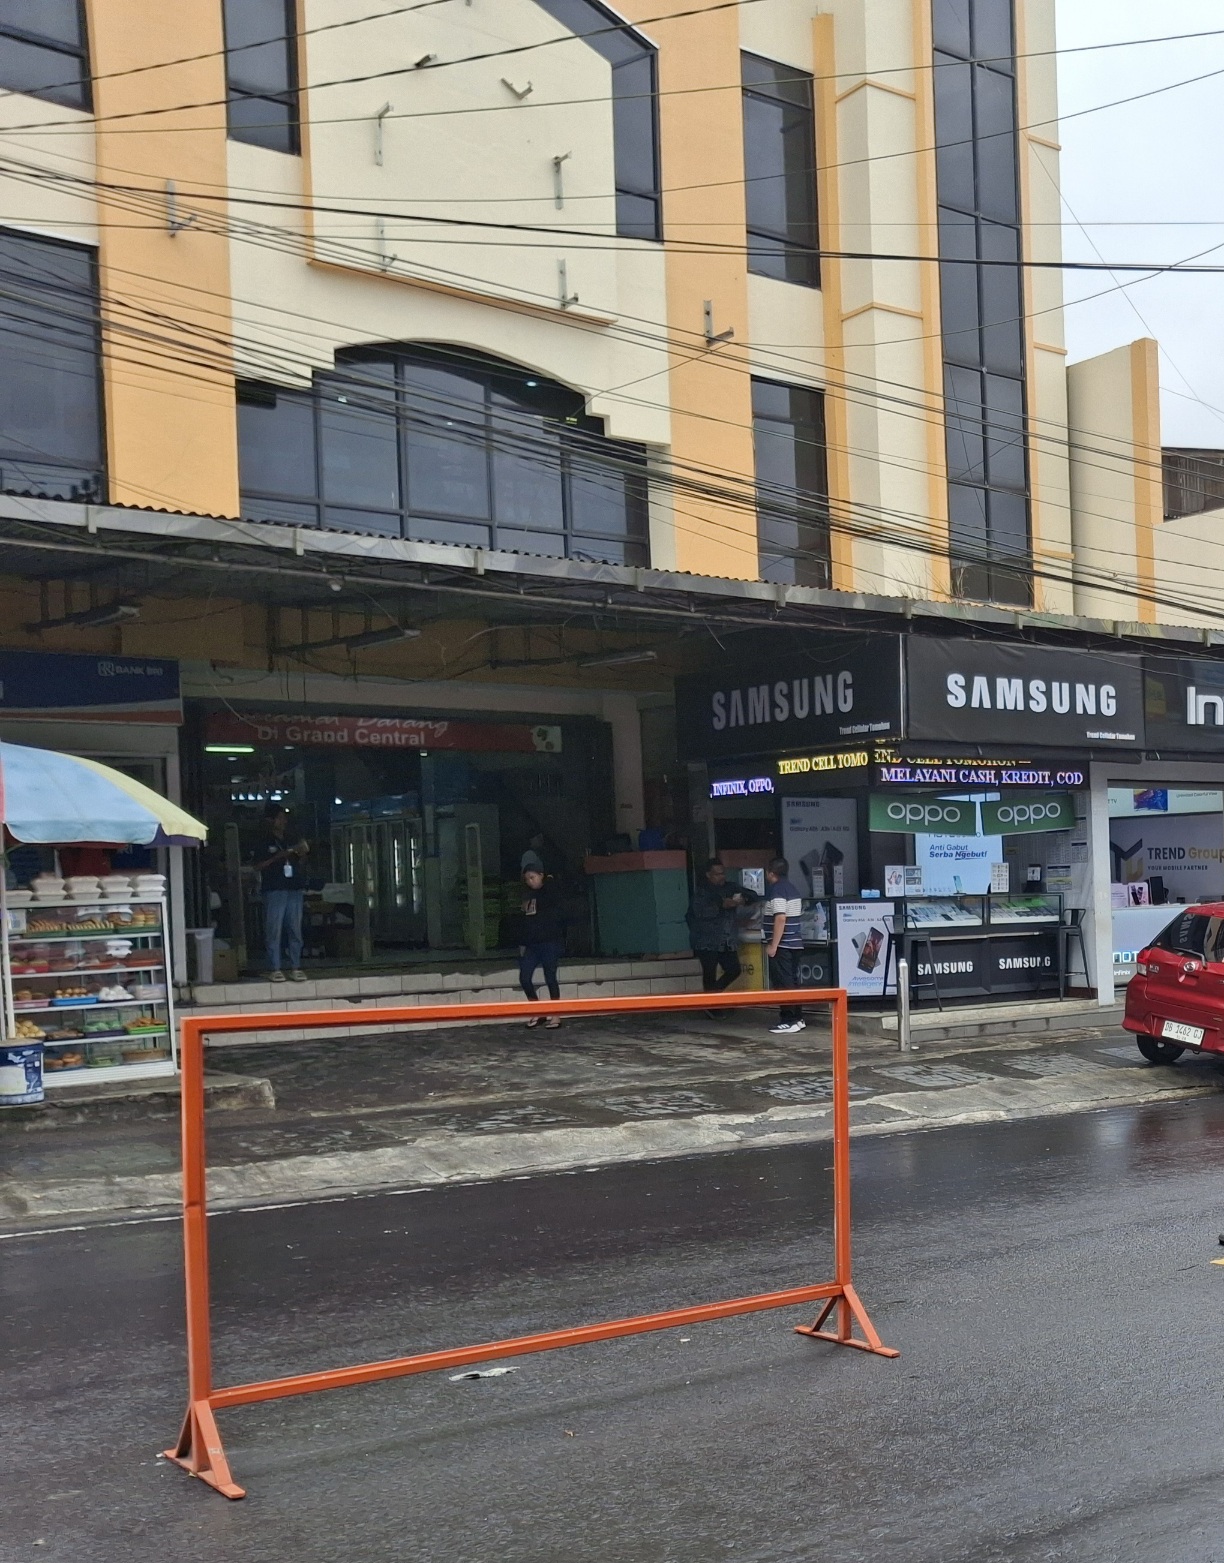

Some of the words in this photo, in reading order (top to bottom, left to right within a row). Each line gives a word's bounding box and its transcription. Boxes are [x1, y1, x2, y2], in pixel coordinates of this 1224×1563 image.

[712, 670, 854, 731] SAMSUNG
[946, 673, 1117, 717] SAMSUNG
[257, 727, 279, 741] Di
[286, 727, 348, 743] Grand
[355, 730, 425, 745] Central
[778, 759, 810, 775] TREND
[811, 755, 836, 771] CELL
[837, 752, 868, 768] TOMO
[881, 767, 957, 783] MELAYANI
[959, 769, 999, 786] CASH,
[1001, 771, 1054, 787] KREDIT,
[1056, 772, 1083, 785] COD
[887, 802, 961, 826] oppo
[997, 802, 1061, 826] oppo
[1147, 847, 1186, 860] TREND
[1188, 847, 1224, 863] Group
[917, 961, 974, 976] SAMSUNG
